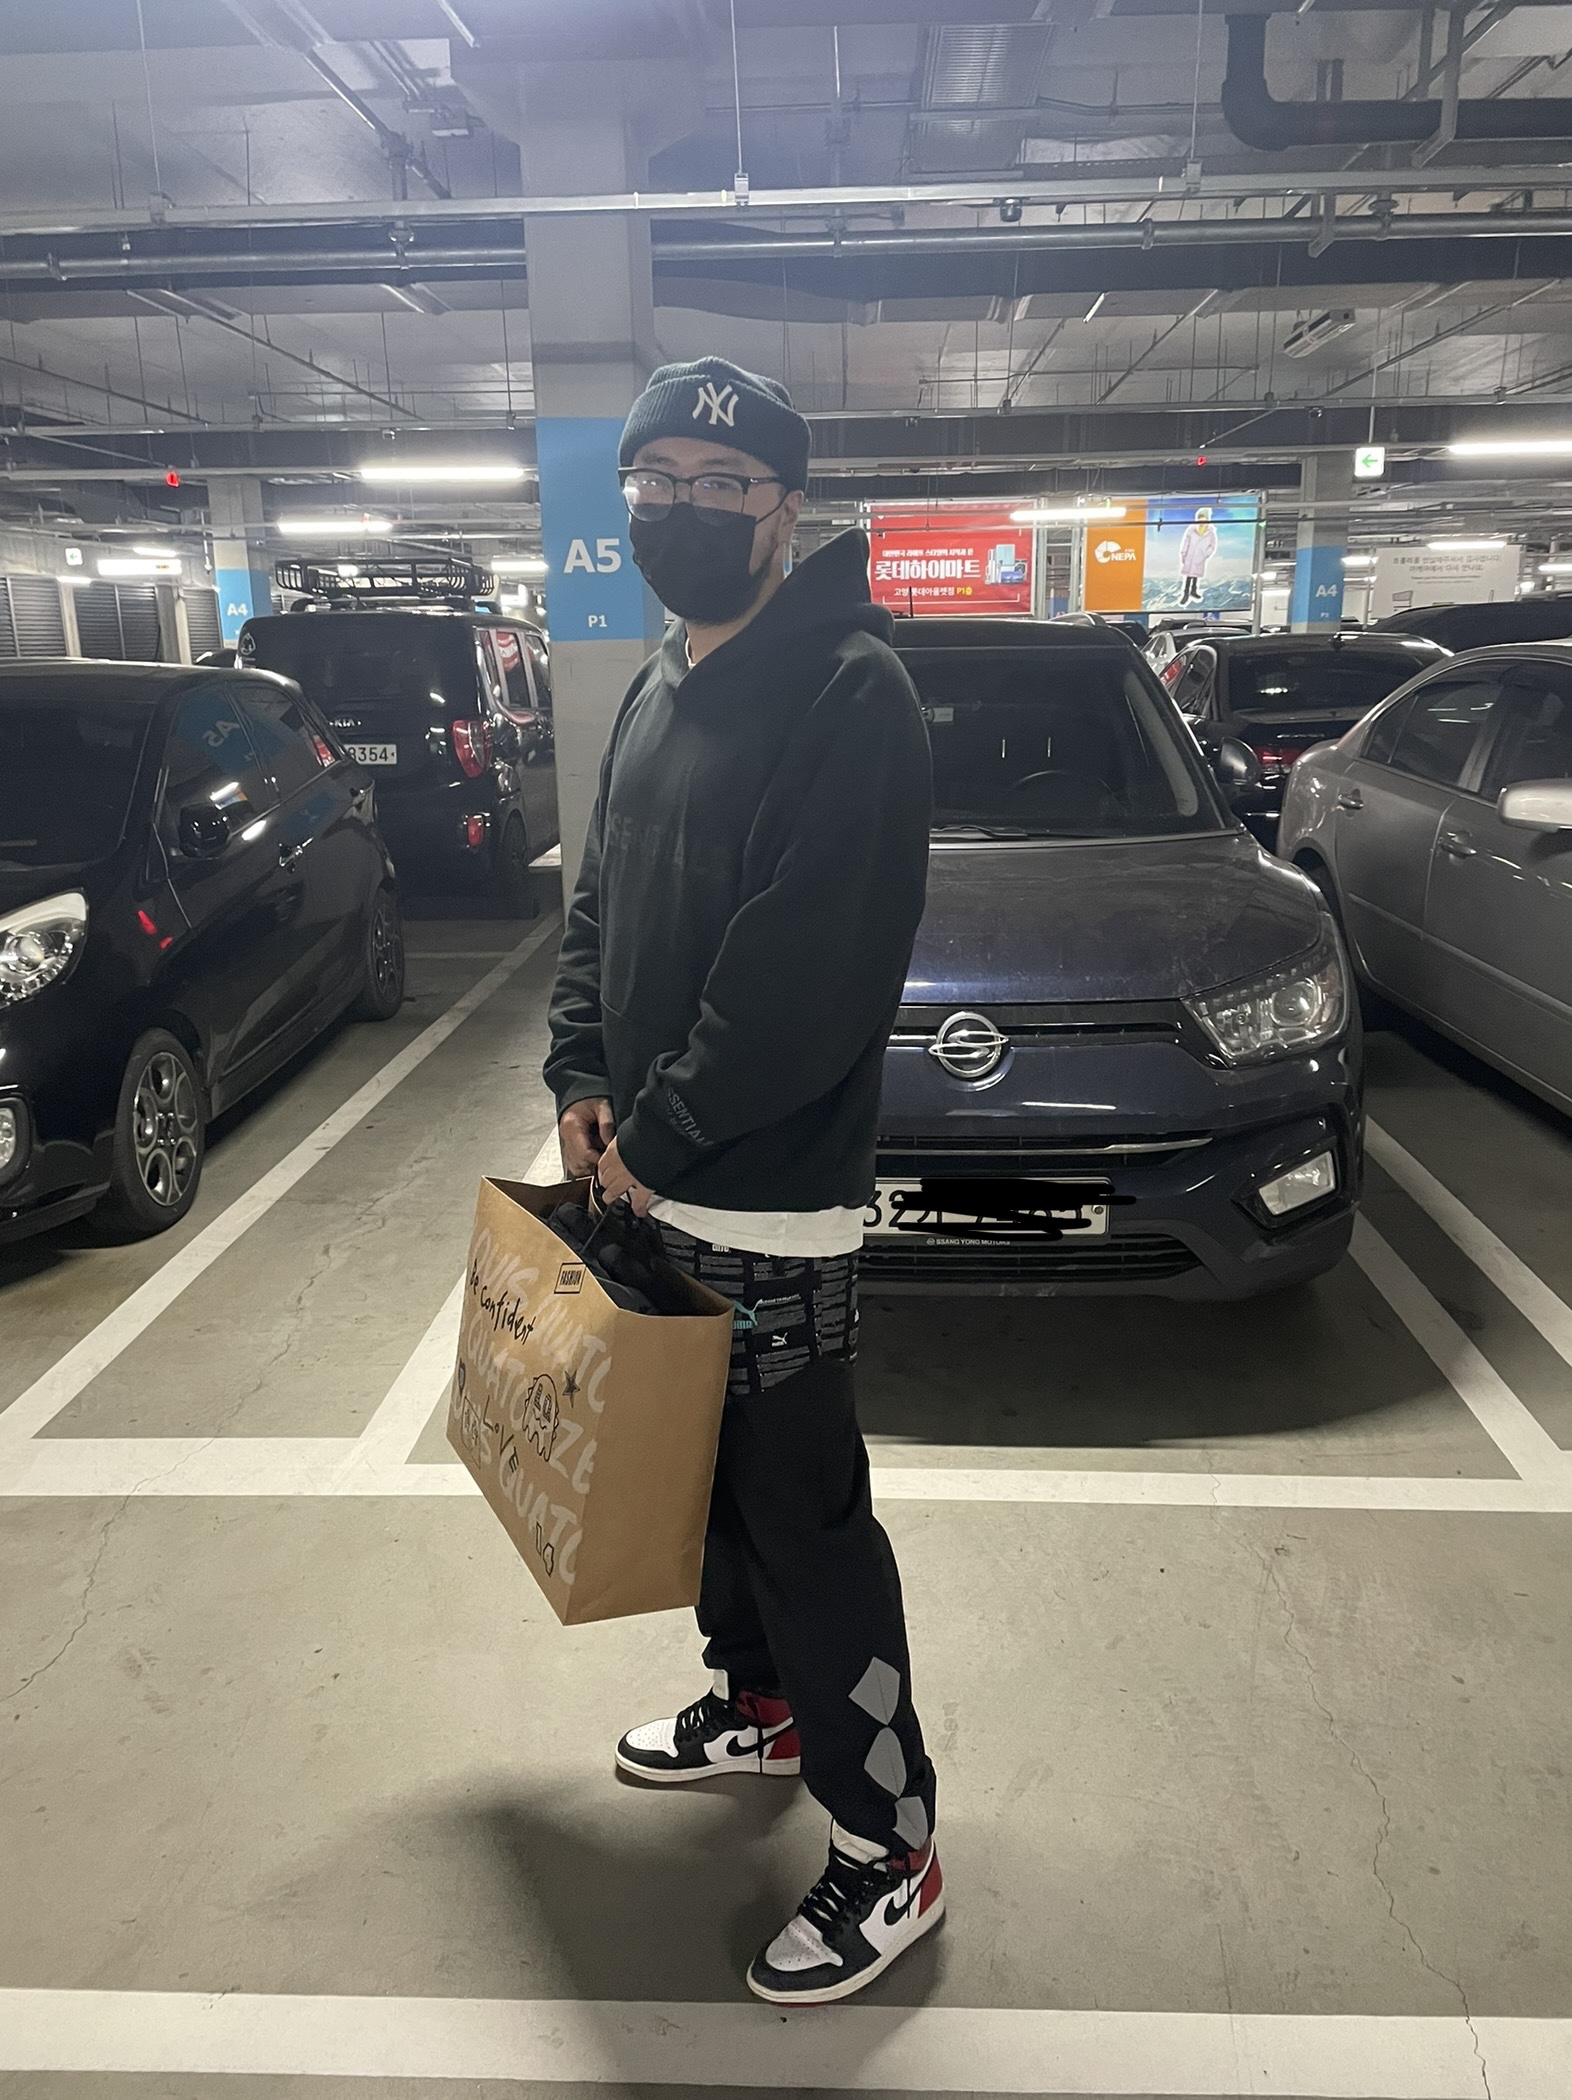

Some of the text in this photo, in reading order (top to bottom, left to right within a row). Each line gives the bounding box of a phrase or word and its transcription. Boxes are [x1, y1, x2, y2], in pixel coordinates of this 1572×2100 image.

[692, 382, 739, 427] NY
[563, 538, 622, 573] A5
[874, 559, 981, 581] 롯데하이마트
[1315, 584, 1339, 598] A4
[227, 603, 248, 616] A4
[588, 614, 607, 628] P1
